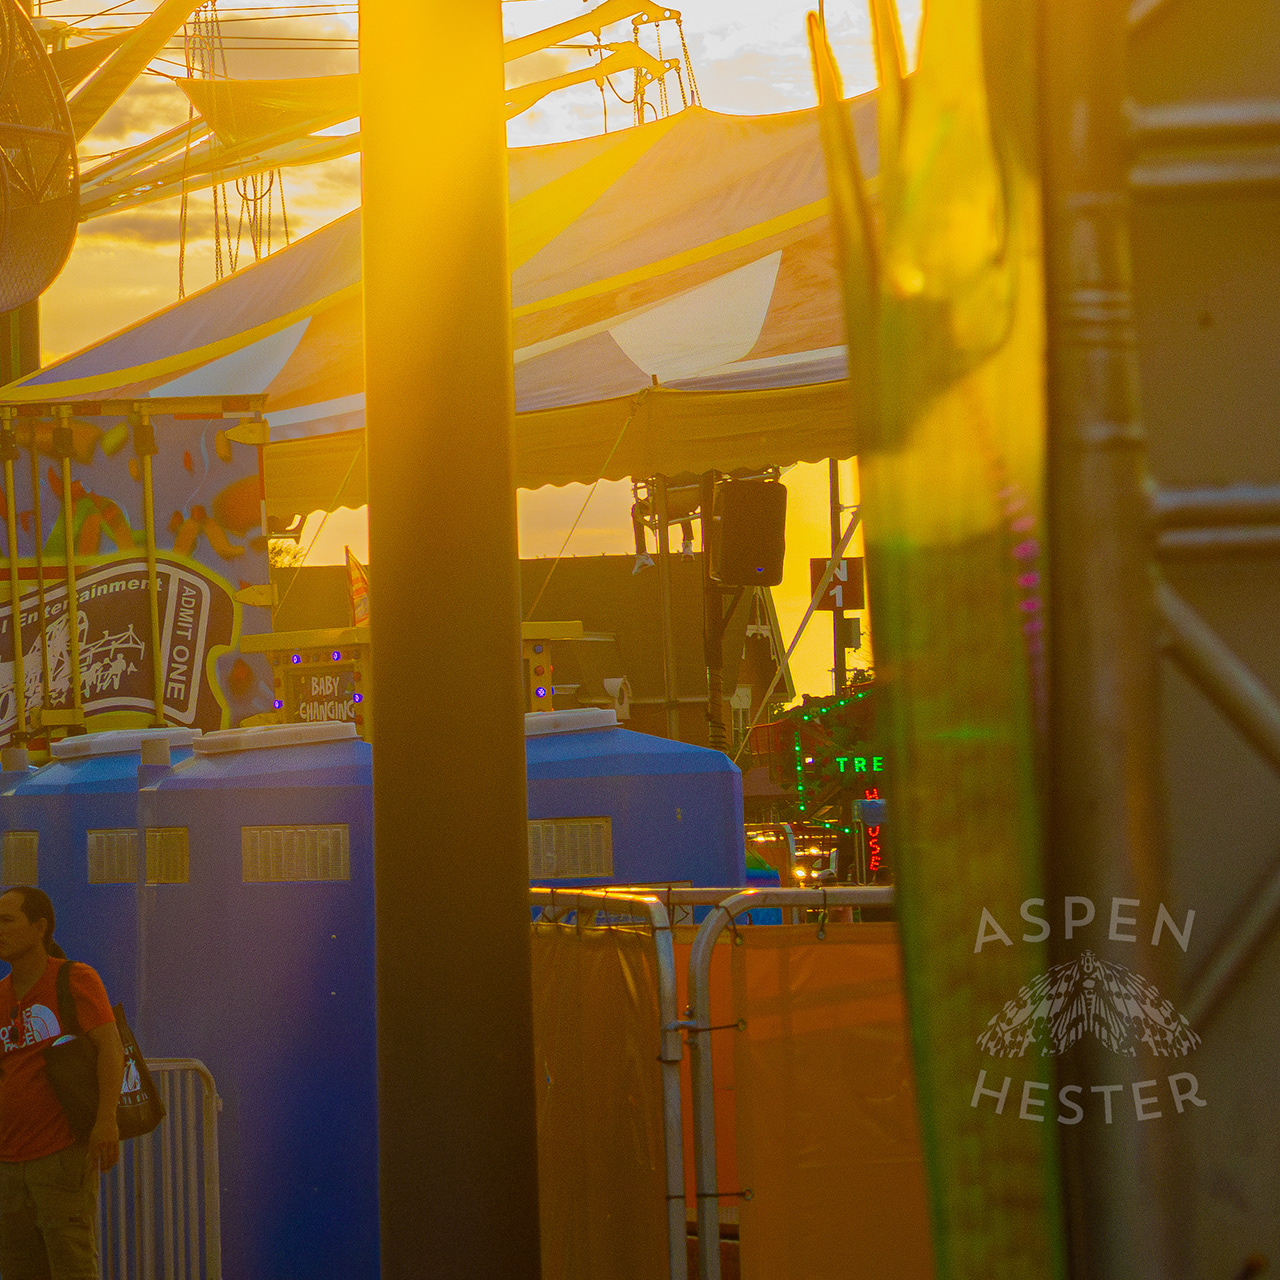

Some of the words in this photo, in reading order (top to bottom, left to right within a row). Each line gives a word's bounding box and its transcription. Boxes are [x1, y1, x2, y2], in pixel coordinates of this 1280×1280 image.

[176, 585, 197, 641] ADMIT
[829, 585, 843, 607] 1
[166, 645, 190, 700] ONE
[311, 676, 339, 696] BABY
[835, 756, 884, 773] TRE
[865, 787, 881, 871] HUSE
